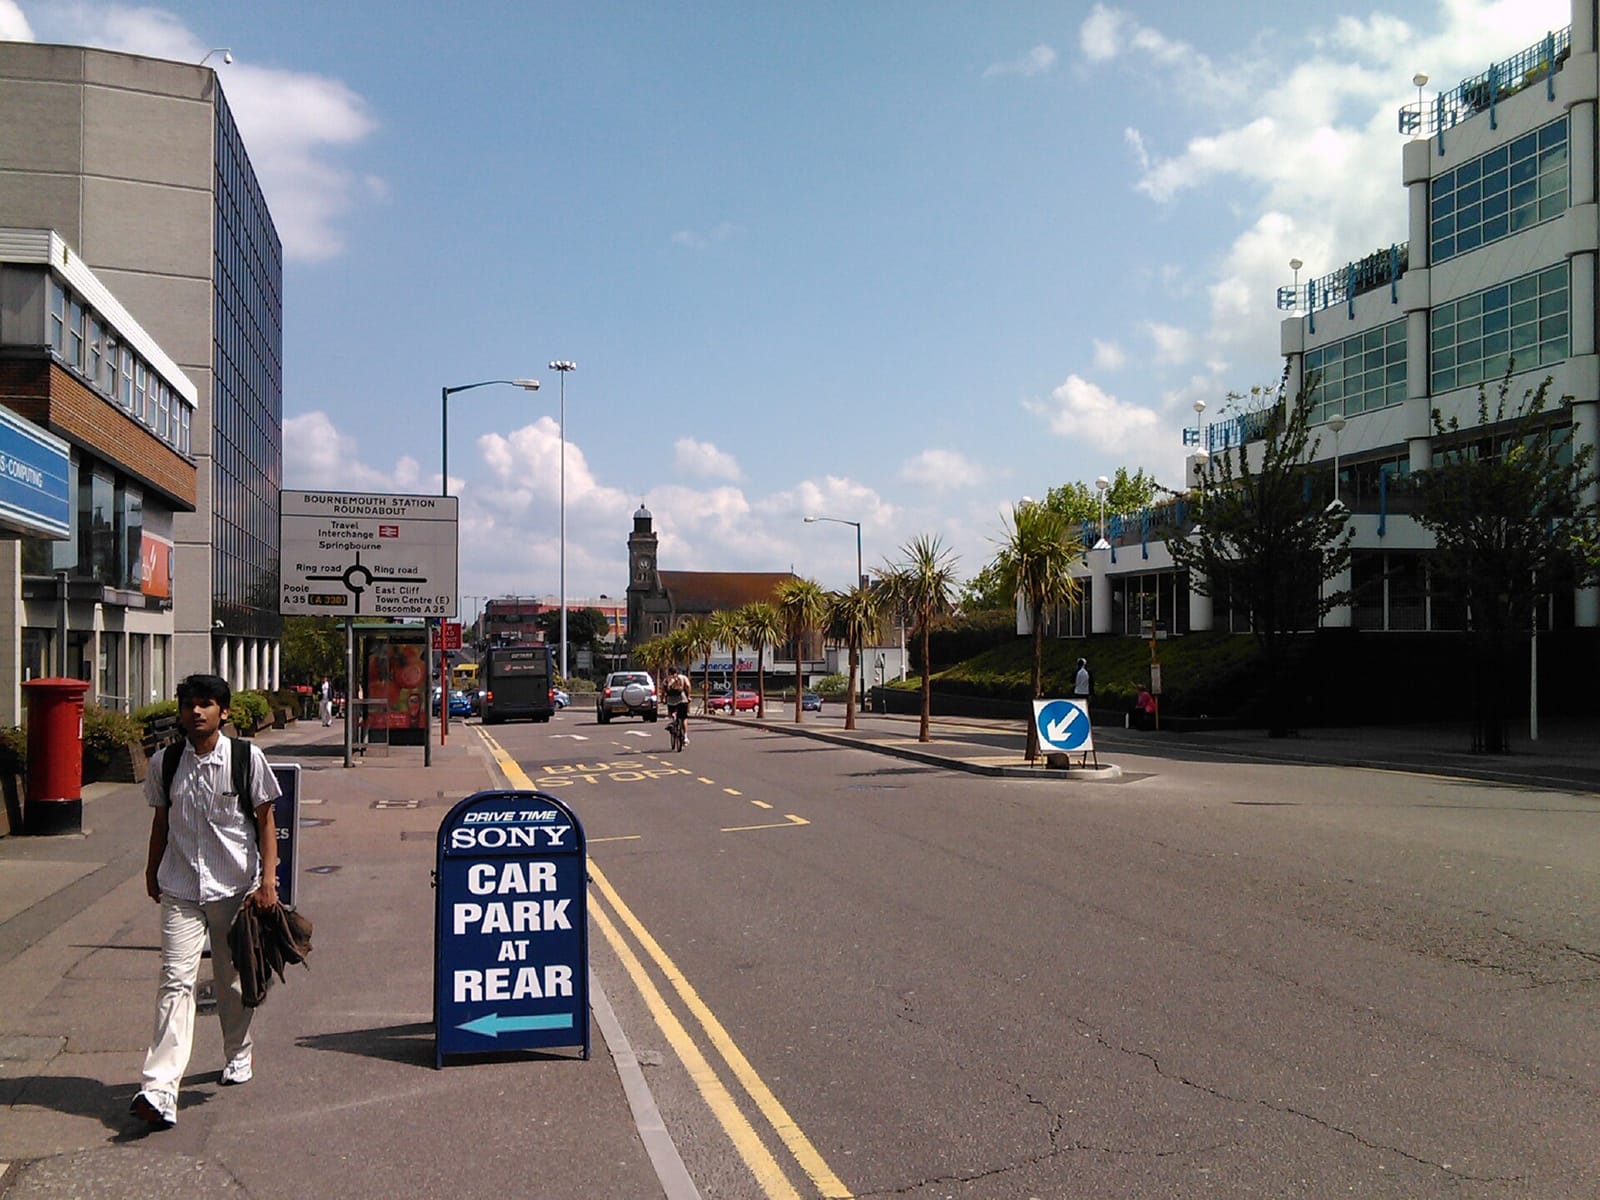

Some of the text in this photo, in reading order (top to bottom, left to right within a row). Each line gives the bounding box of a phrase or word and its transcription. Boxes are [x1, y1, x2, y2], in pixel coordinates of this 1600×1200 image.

[304, 495, 435, 508] BOURNEMOUTH STATION
[333, 505, 406, 515] ROUNDABOUT
[331, 521, 359, 529] Travel
[318, 529, 374, 539] Interchange
[319, 541, 382, 550] Springbourne
[296, 563, 317, 573] Ring
[374, 565, 418, 574] Ring road
[283, 584, 310, 592] Poole
[375, 586, 419, 594] East Cliff
[376, 595, 450, 605] Town Centre (E)
[375, 605, 422, 613] Boscombe
[542, 760, 644, 774] BUS
[535, 769, 679, 788] STOP
[464, 810, 558, 822] DRIVE TIME
[451, 825, 571, 849] SONY
[468, 862, 557, 895] CAR
[453, 899, 573, 935] PARK
[497, 940, 530, 962] AT
[453, 965, 573, 1003] REAR
